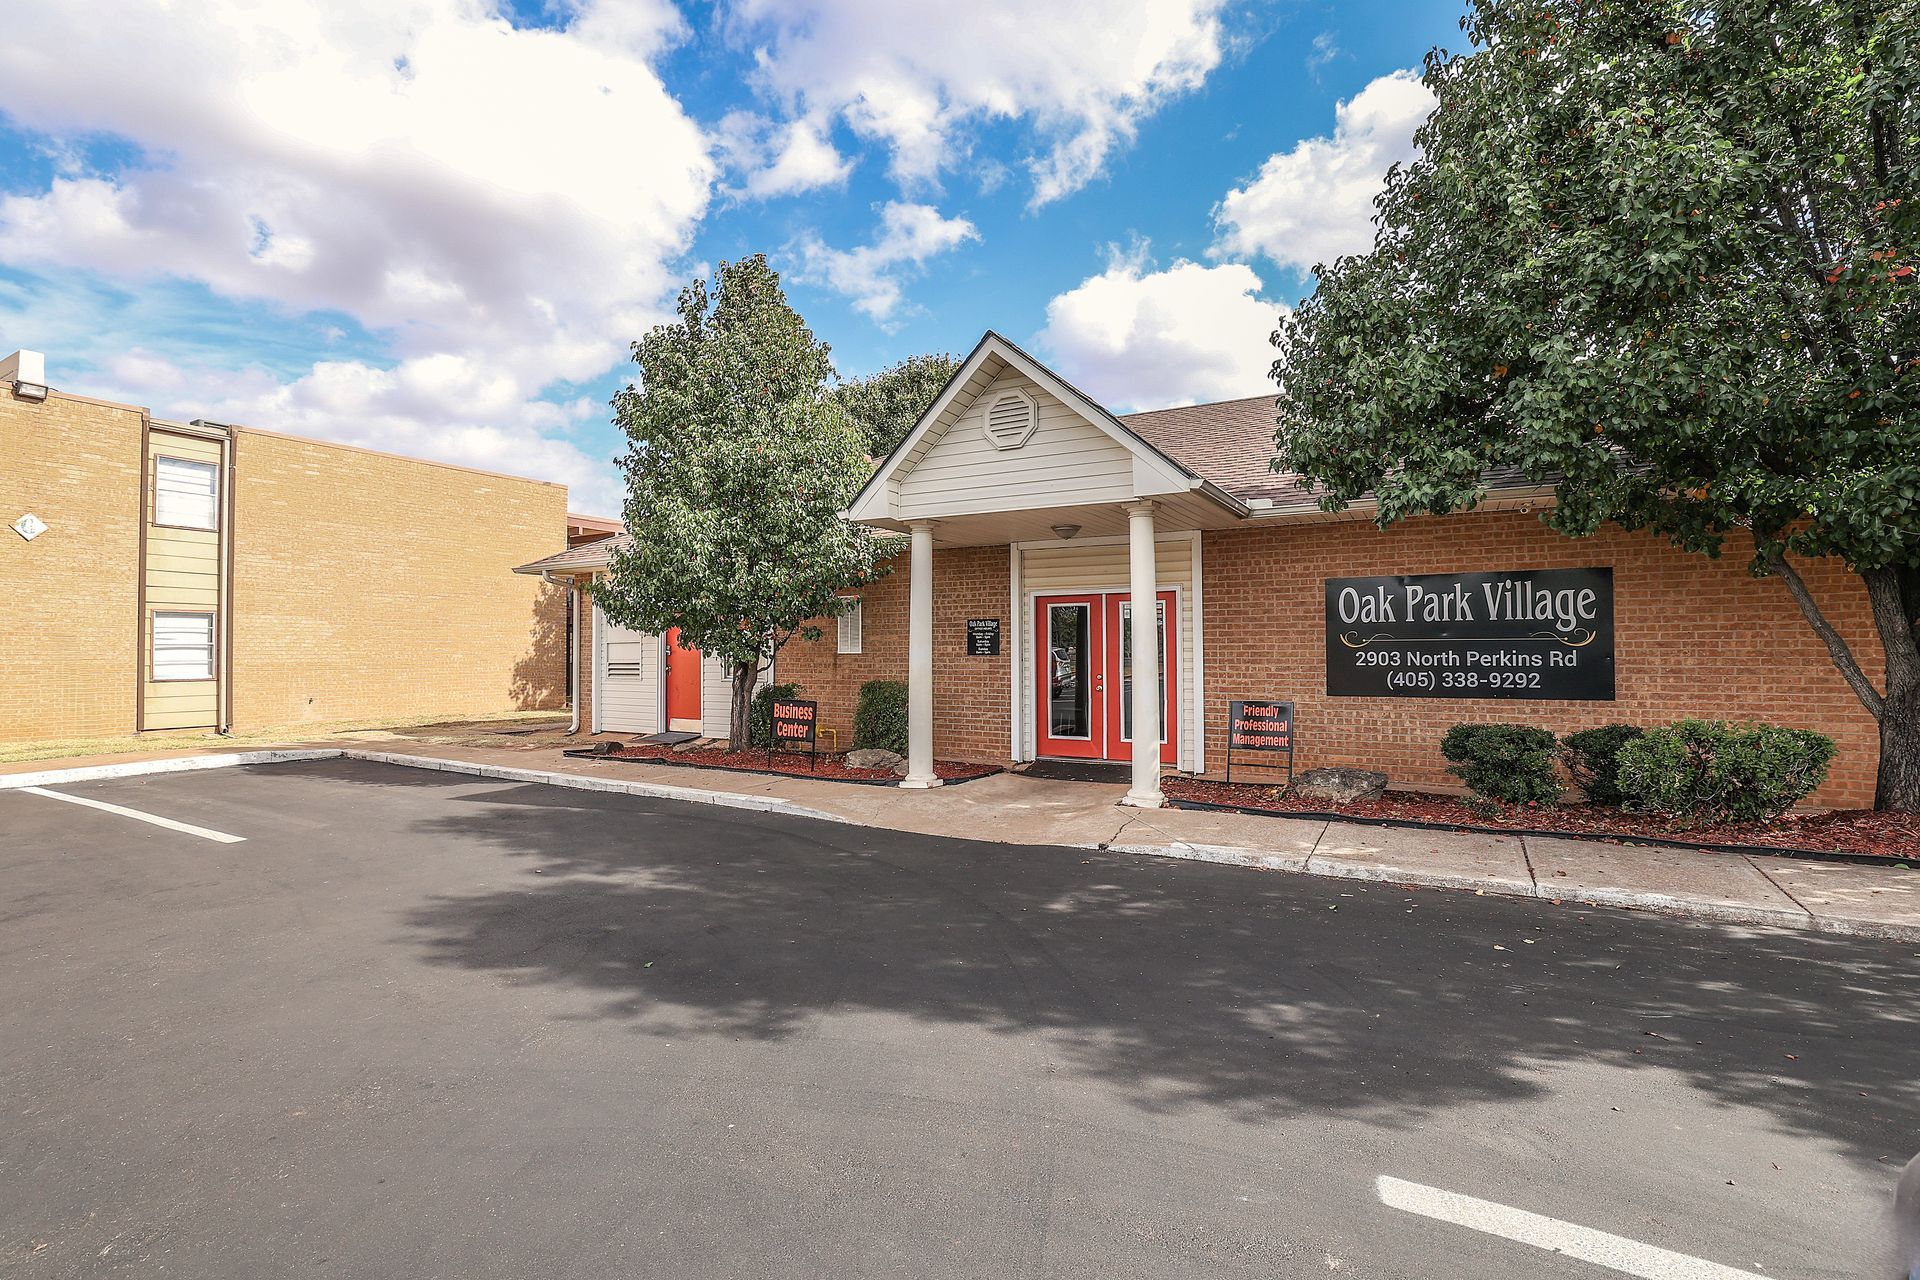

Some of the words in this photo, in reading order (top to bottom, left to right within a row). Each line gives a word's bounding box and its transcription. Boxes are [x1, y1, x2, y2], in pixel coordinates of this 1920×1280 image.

[1338, 585, 1397, 624] Oak
[1405, 582, 1474, 623] Park
[1481, 579, 1597, 632] Village
[1355, 651, 1401, 667] 2903
[1406, 650, 1460, 667] North
[1466, 650, 1543, 667] Perkins
[1549, 650, 1577, 667] Rd
[1386, 670, 1436, 691] (405)
[1442, 671, 1541, 689] 338-9292
[773, 703, 813, 720] Business
[1243, 704, 1279, 719] Friendly
[777, 721, 809, 738] Center
[1234, 719, 1288, 732] Professional
[1232, 733, 1289, 747] Management
